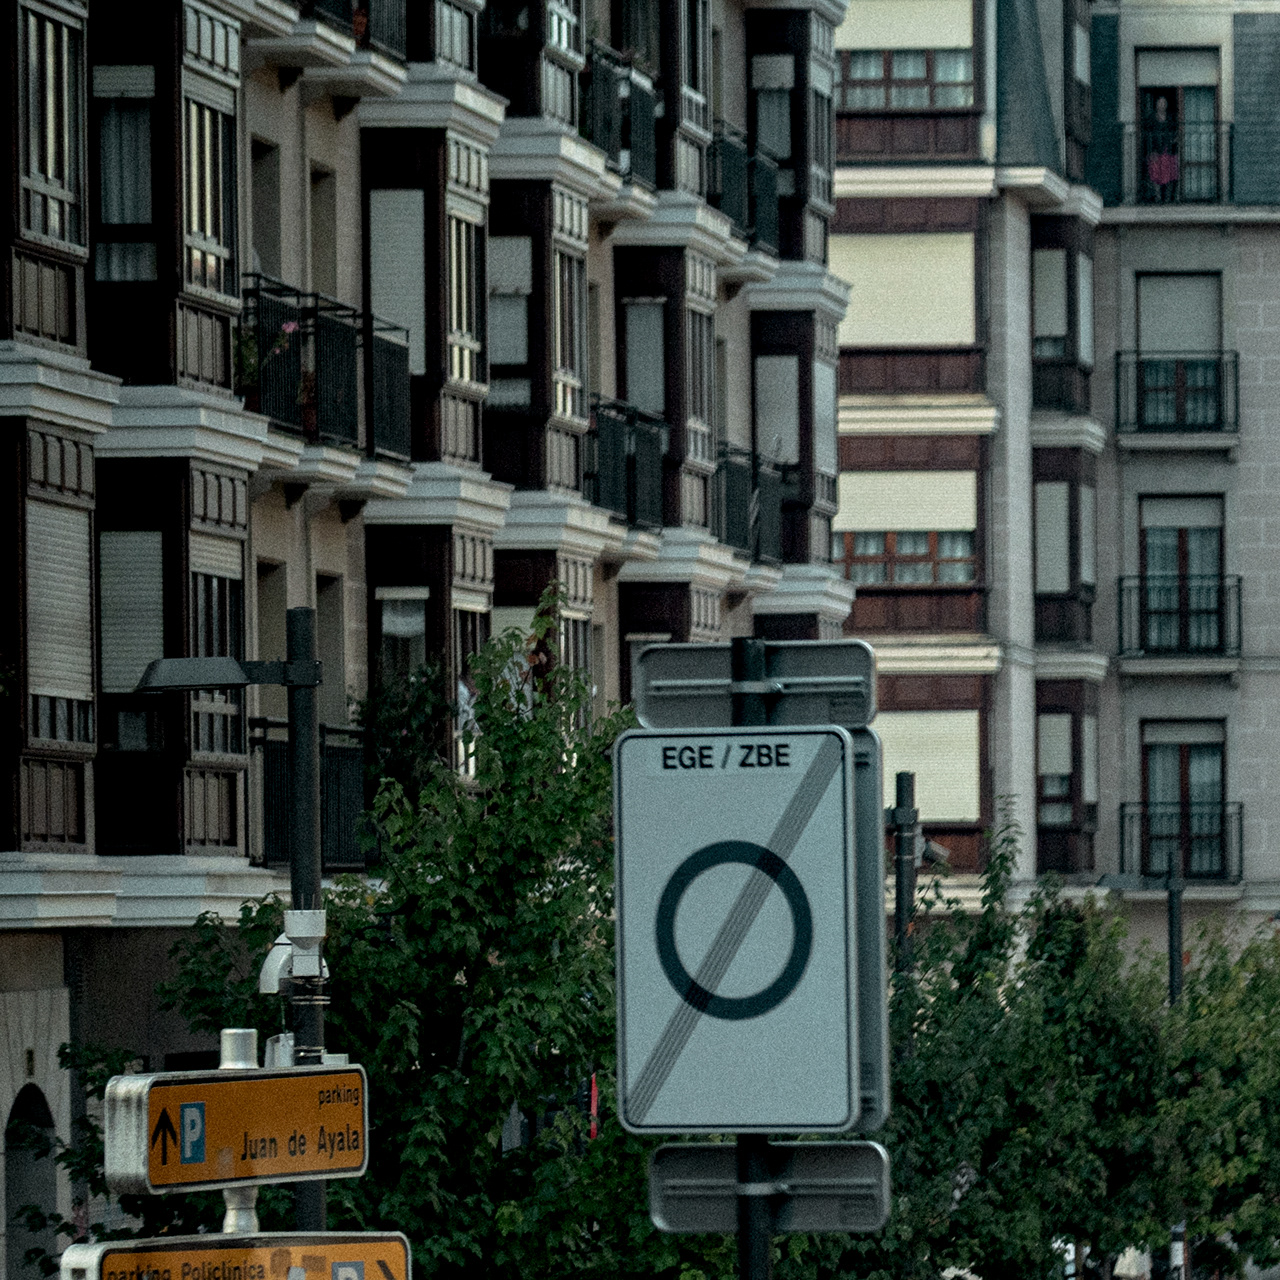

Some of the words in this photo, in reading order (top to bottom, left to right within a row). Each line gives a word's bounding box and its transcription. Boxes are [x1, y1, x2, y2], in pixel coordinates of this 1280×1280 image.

[663, 745, 713, 769] EGE
[739, 743, 790, 768] ZBE
[318, 1083, 359, 1110] parking
[241, 1131, 277, 1160] Juan
[287, 1129, 306, 1157] de
[317, 1123, 359, 1159] Ayala
